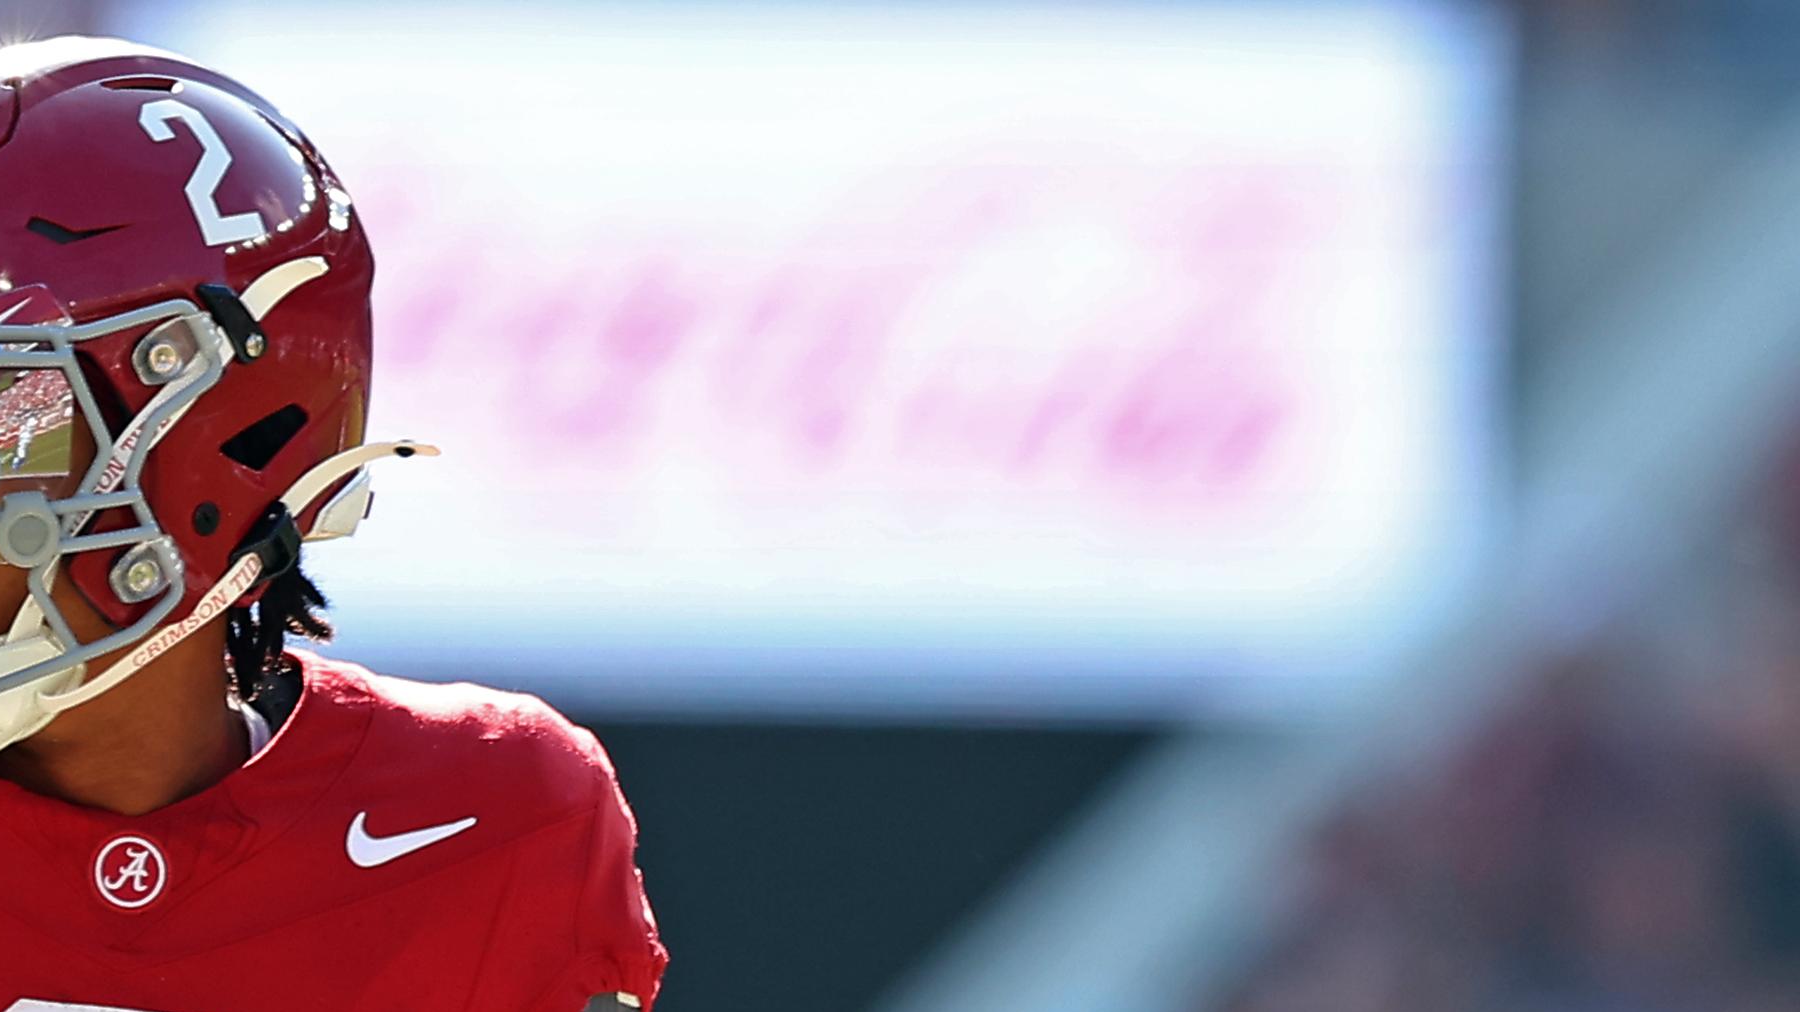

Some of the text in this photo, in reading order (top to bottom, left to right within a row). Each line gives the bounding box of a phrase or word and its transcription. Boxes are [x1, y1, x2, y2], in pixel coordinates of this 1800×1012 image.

[138, 98, 267, 247] 2
[131, 556, 263, 667] CRIMSON TID
[104, 847, 150, 892] A
